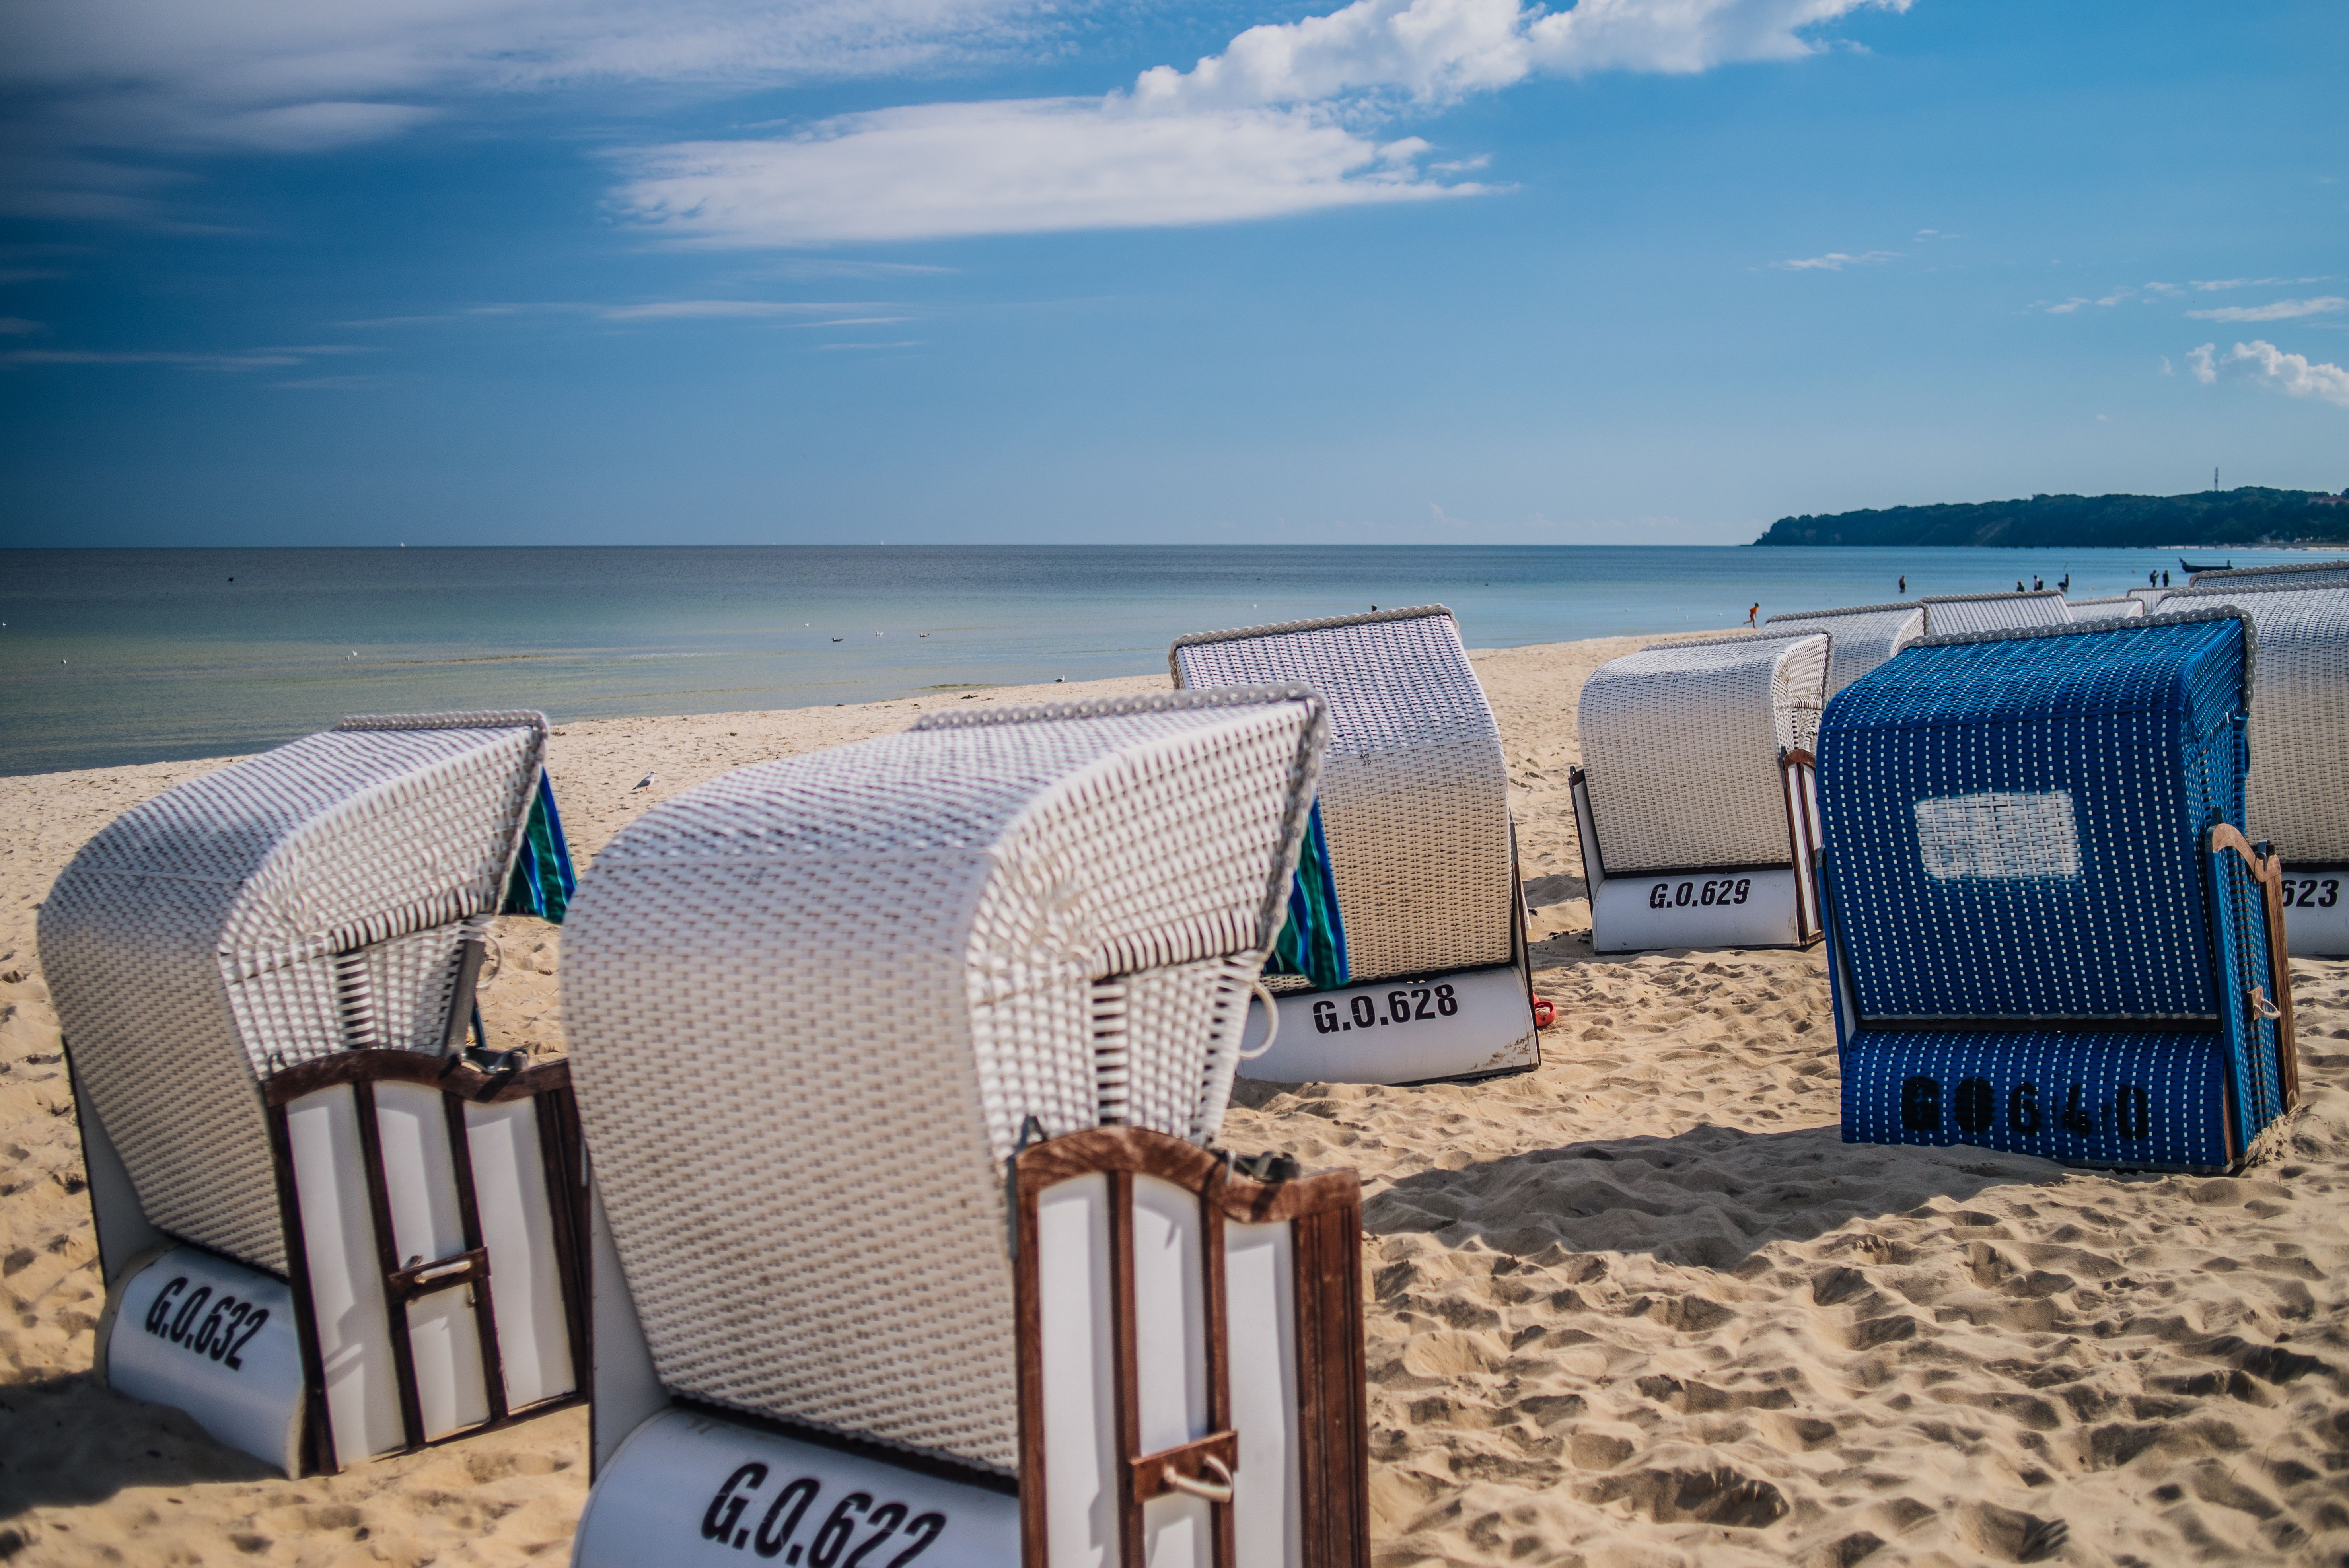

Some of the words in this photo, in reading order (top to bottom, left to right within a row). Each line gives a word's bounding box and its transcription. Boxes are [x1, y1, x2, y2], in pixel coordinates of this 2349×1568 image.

[1649, 879, 1751, 909] G.O.629
[1313, 984, 1458, 1034] G.O.628
[146, 1277, 270, 1370] G.O.632
